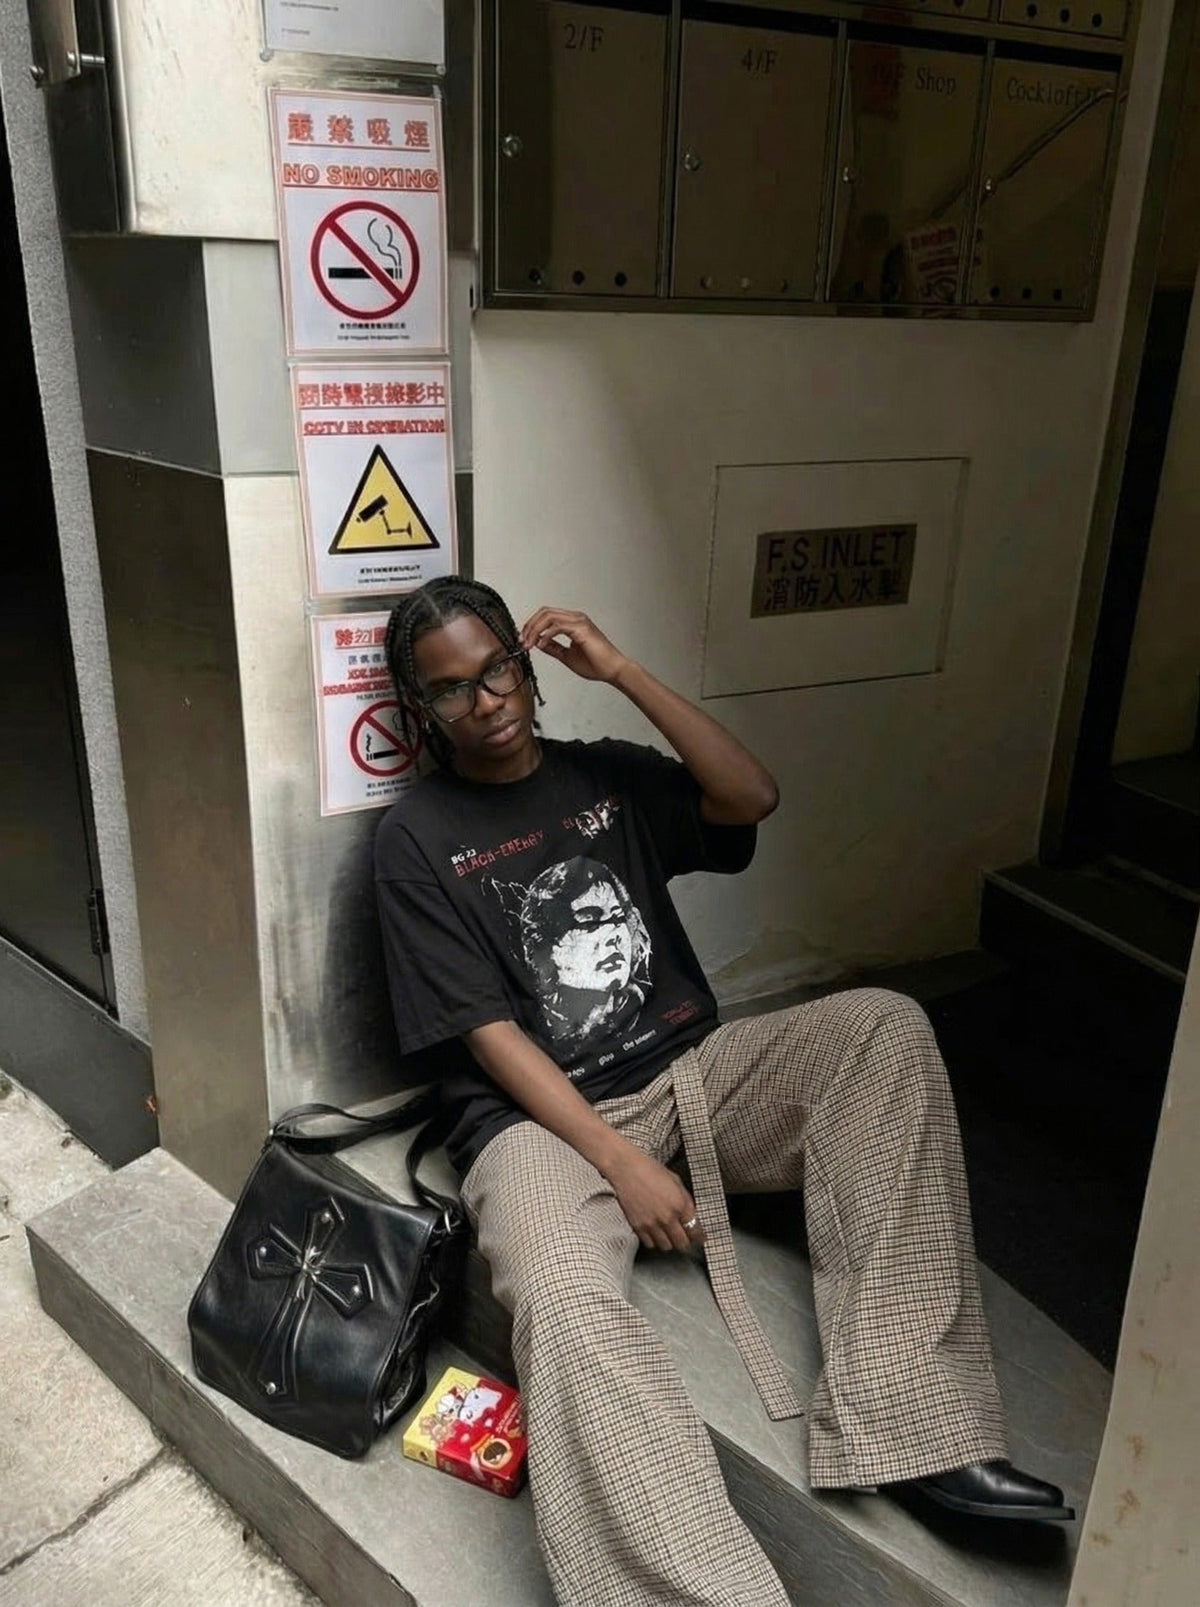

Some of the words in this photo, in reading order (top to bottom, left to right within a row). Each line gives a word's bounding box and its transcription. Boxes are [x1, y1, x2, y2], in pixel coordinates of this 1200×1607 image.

[564, 23, 604, 52] 2/F
[741, 48, 778, 75] 4/F
[915, 67, 957, 95] Shop
[287, 112, 430, 147] 嚴禁吸煙
[283, 163, 320, 184] NO
[326, 165, 439, 189] SMOKING
[303, 421, 344, 434] CCTV
[365, 419, 445, 433] OPERATION
[821, 530, 906, 569] INLET
